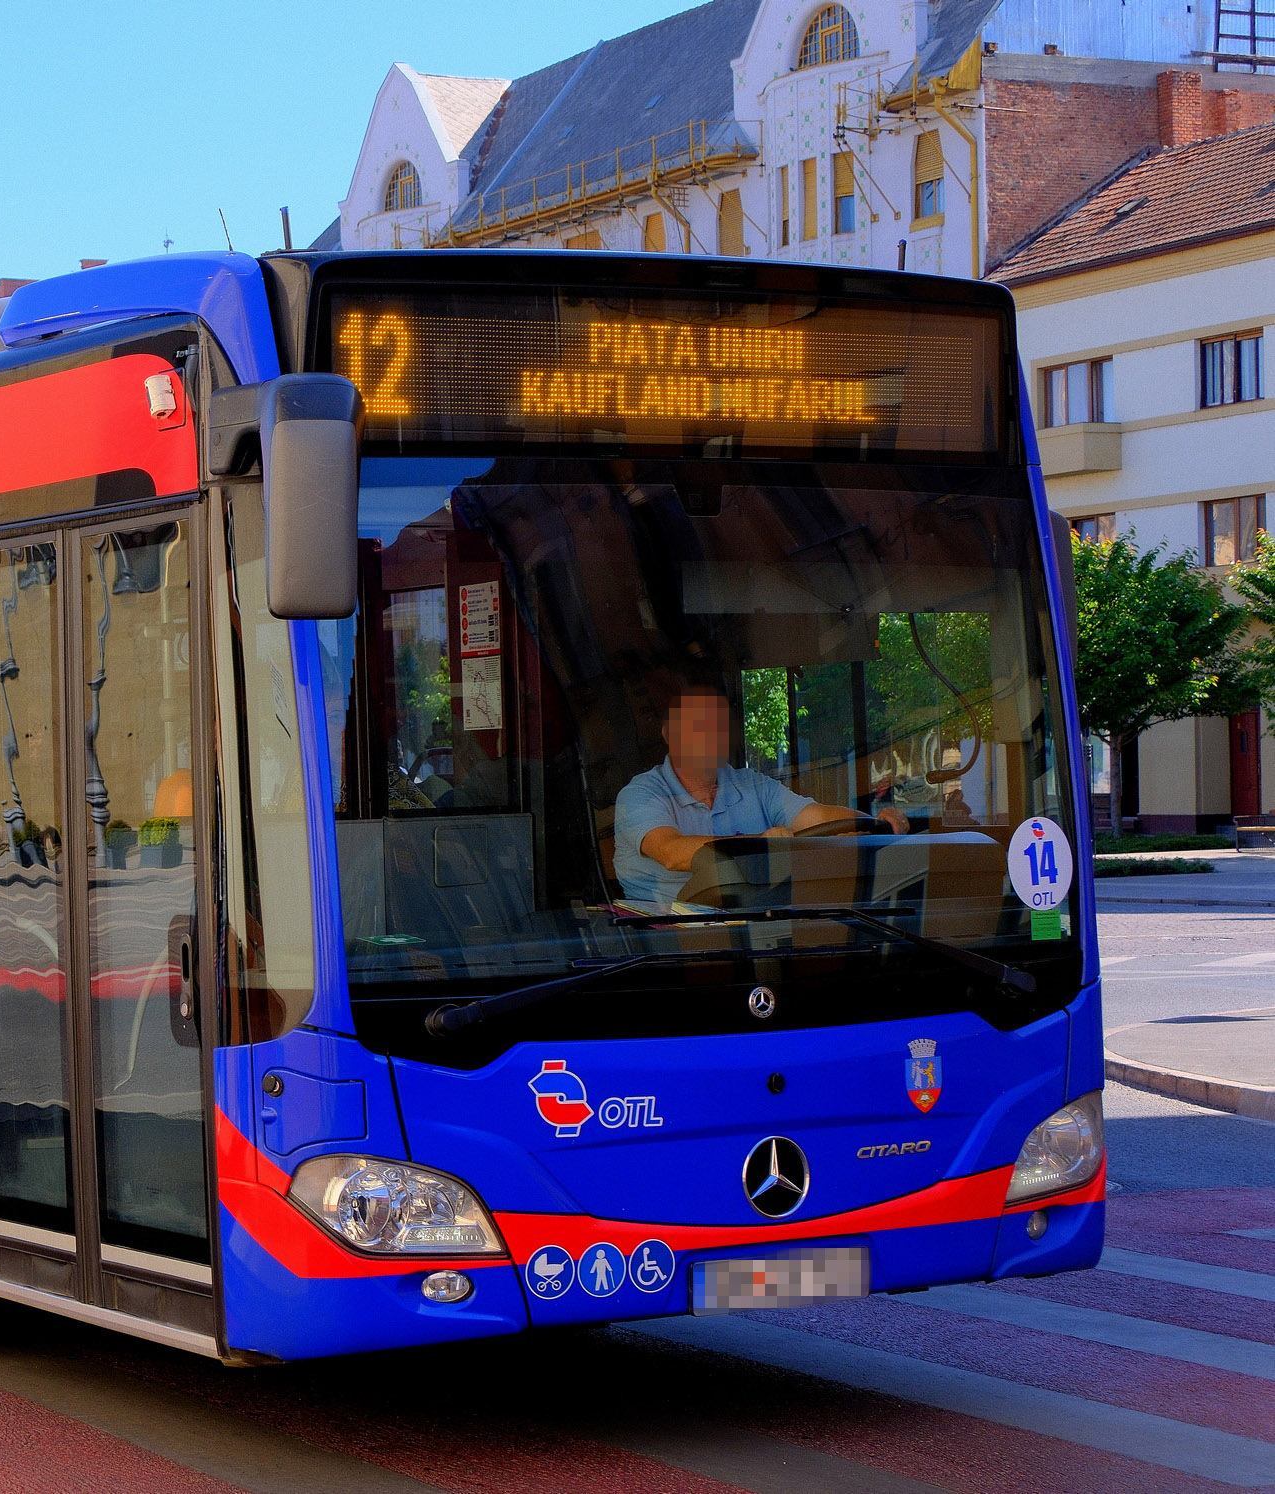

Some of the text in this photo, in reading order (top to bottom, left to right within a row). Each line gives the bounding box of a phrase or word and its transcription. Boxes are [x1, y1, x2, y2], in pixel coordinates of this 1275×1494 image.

[339, 311, 410, 415] 12
[589, 323, 804, 369] PIATA UNIRII
[521, 371, 877, 420] KAUFLAND NUFARUL
[1024, 841, 1058, 886] 14
[1032, 892, 1056, 906] OTL
[598, 1096, 663, 1129] OTL
[857, 1140, 932, 1159] CITARO
